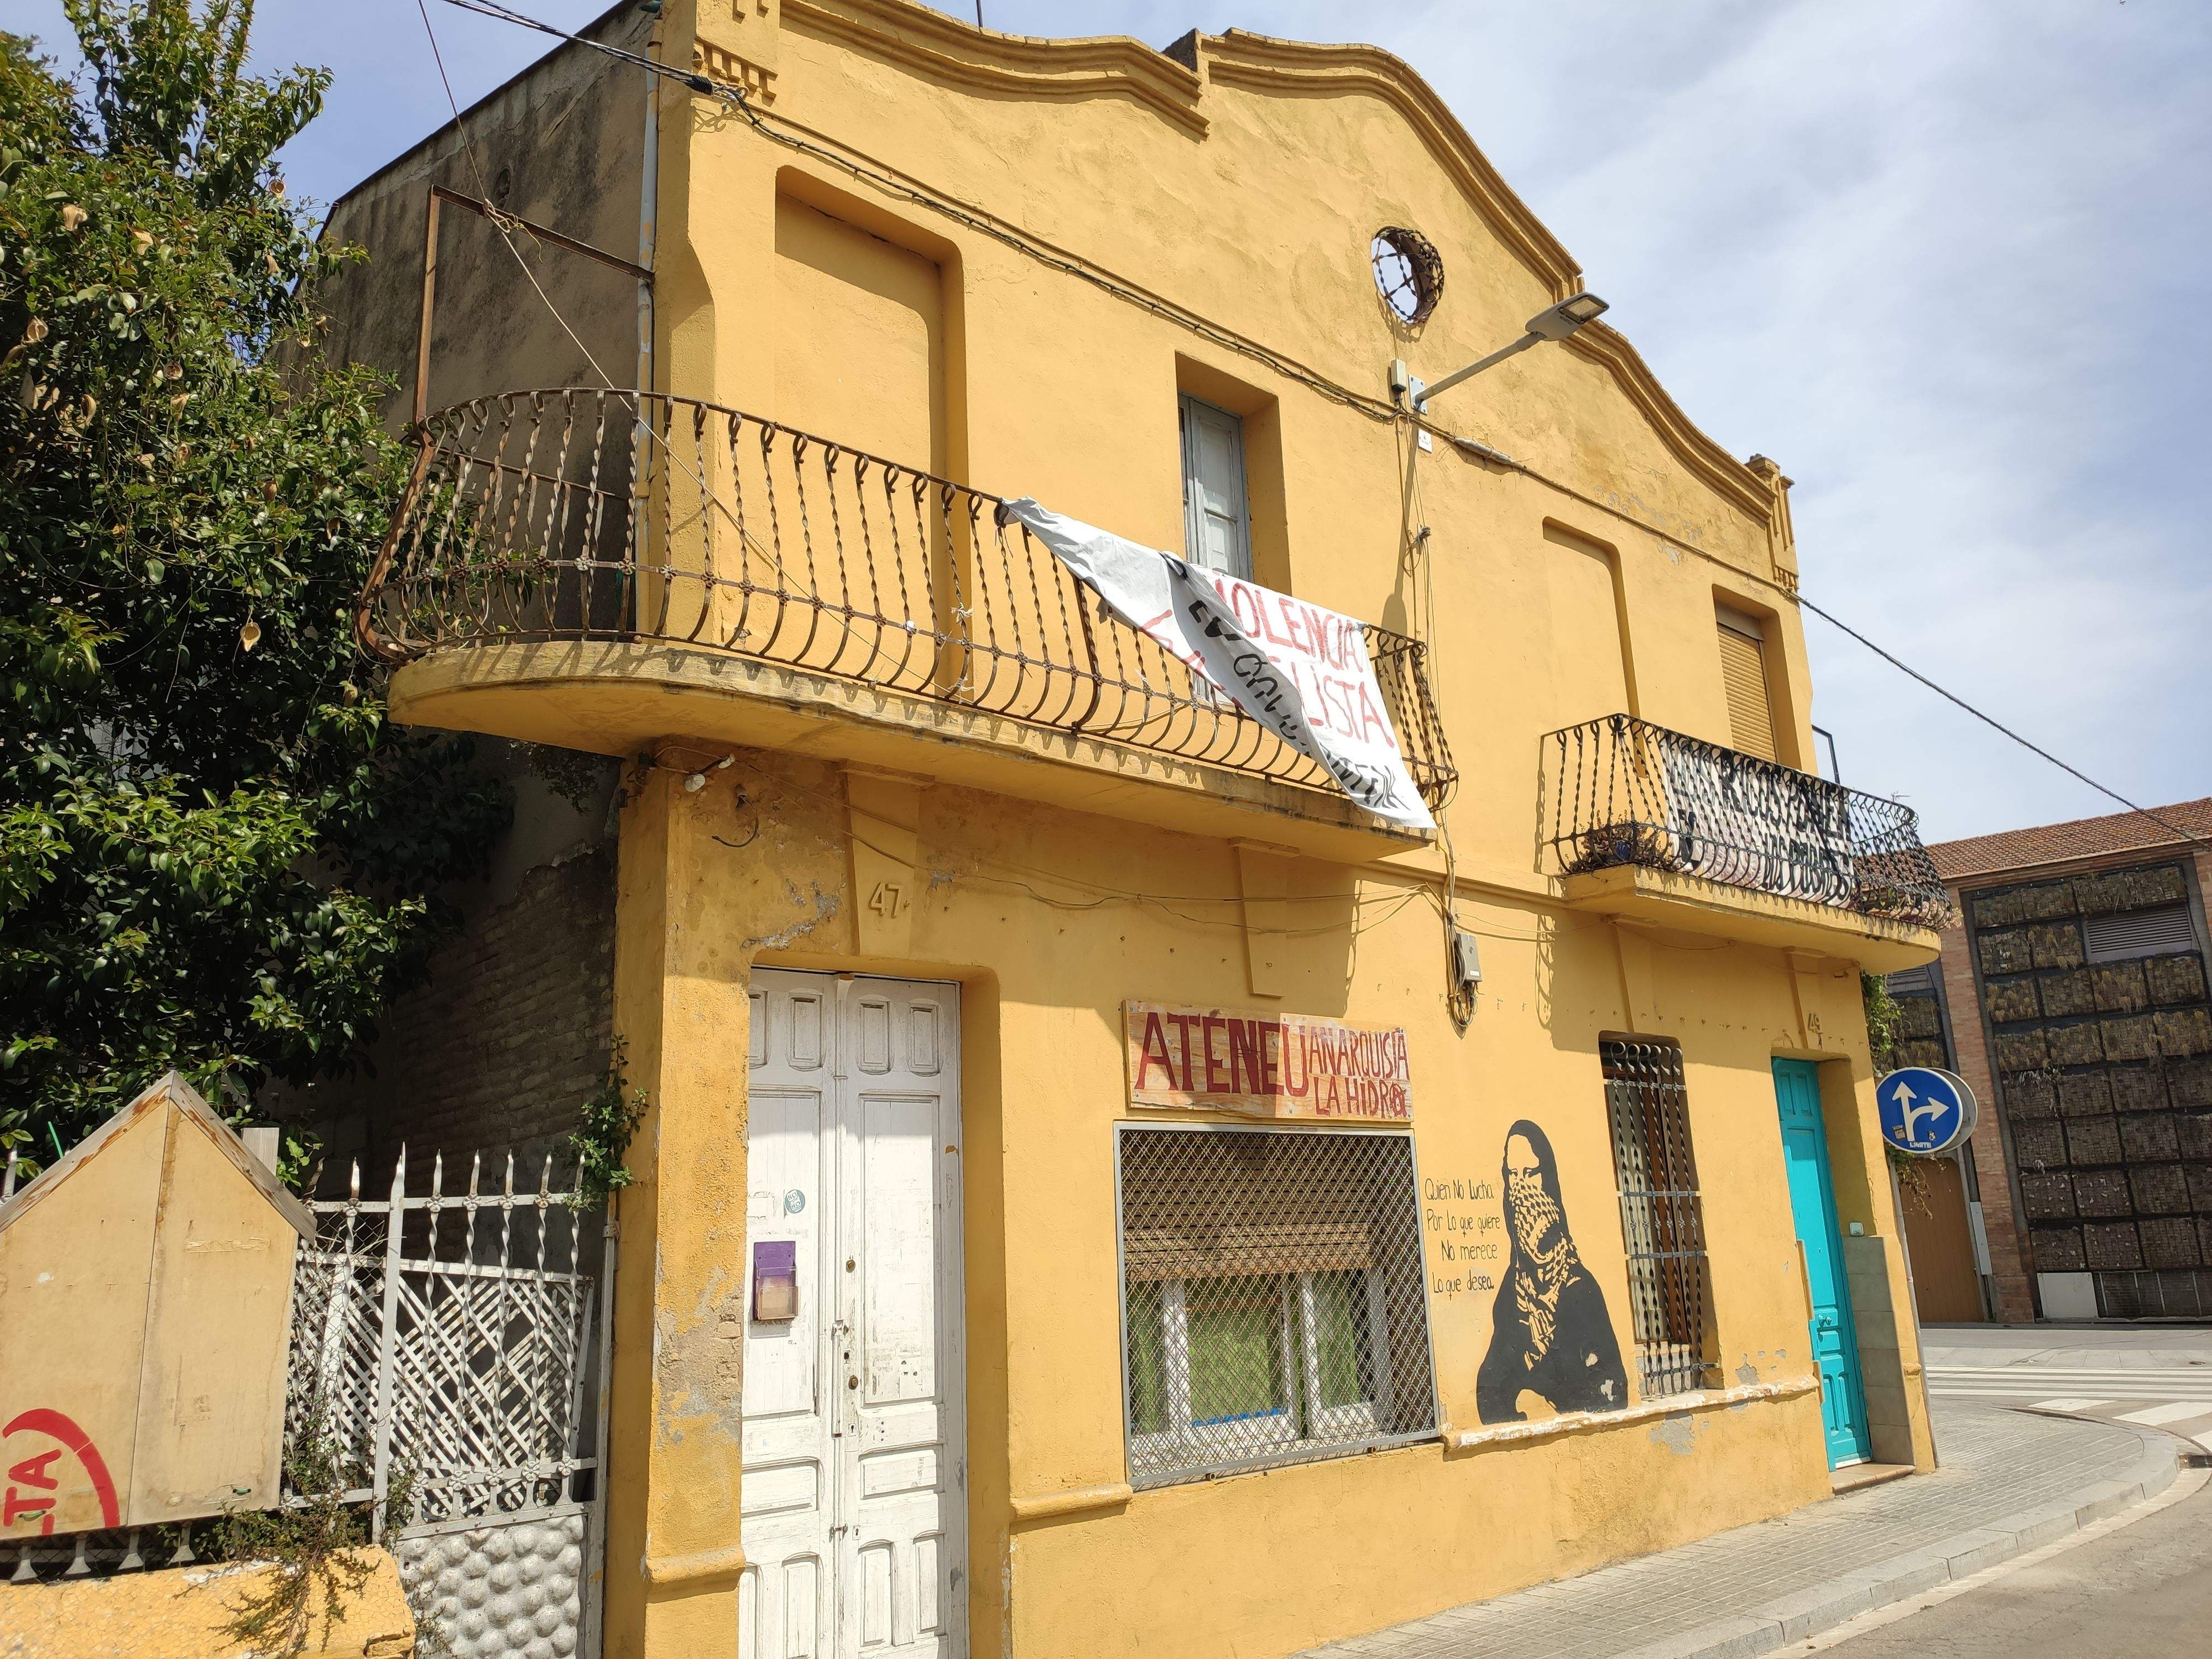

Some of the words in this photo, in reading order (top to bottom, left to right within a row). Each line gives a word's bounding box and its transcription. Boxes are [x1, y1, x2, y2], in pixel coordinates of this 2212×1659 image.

[1267, 656, 1395, 749] LISTA
[868, 882, 904, 919] 47
[1807, 1013, 1821, 1034] 49
[1134, 1012, 1309, 1097] ATENEU
[1313, 1076, 1342, 1116] LA
[1425, 1178, 1451, 1201] Quien
[1453, 1178, 1464, 1200] No
[1468, 1178, 1495, 1200] Lucha
[1427, 1208, 1443, 1231] Por
[1447, 1209, 1457, 1230] Lo
[1460, 1217, 1474, 1238] que
[1478, 1213, 1501, 1238] quiere
[1441, 1239, 1455, 1261] No
[1460, 1244, 1498, 1260] merece
[1432, 1272, 1444, 1293] Lo
[1446, 1278, 1462, 1301] que
[3, 1448, 62, 1535] TA
